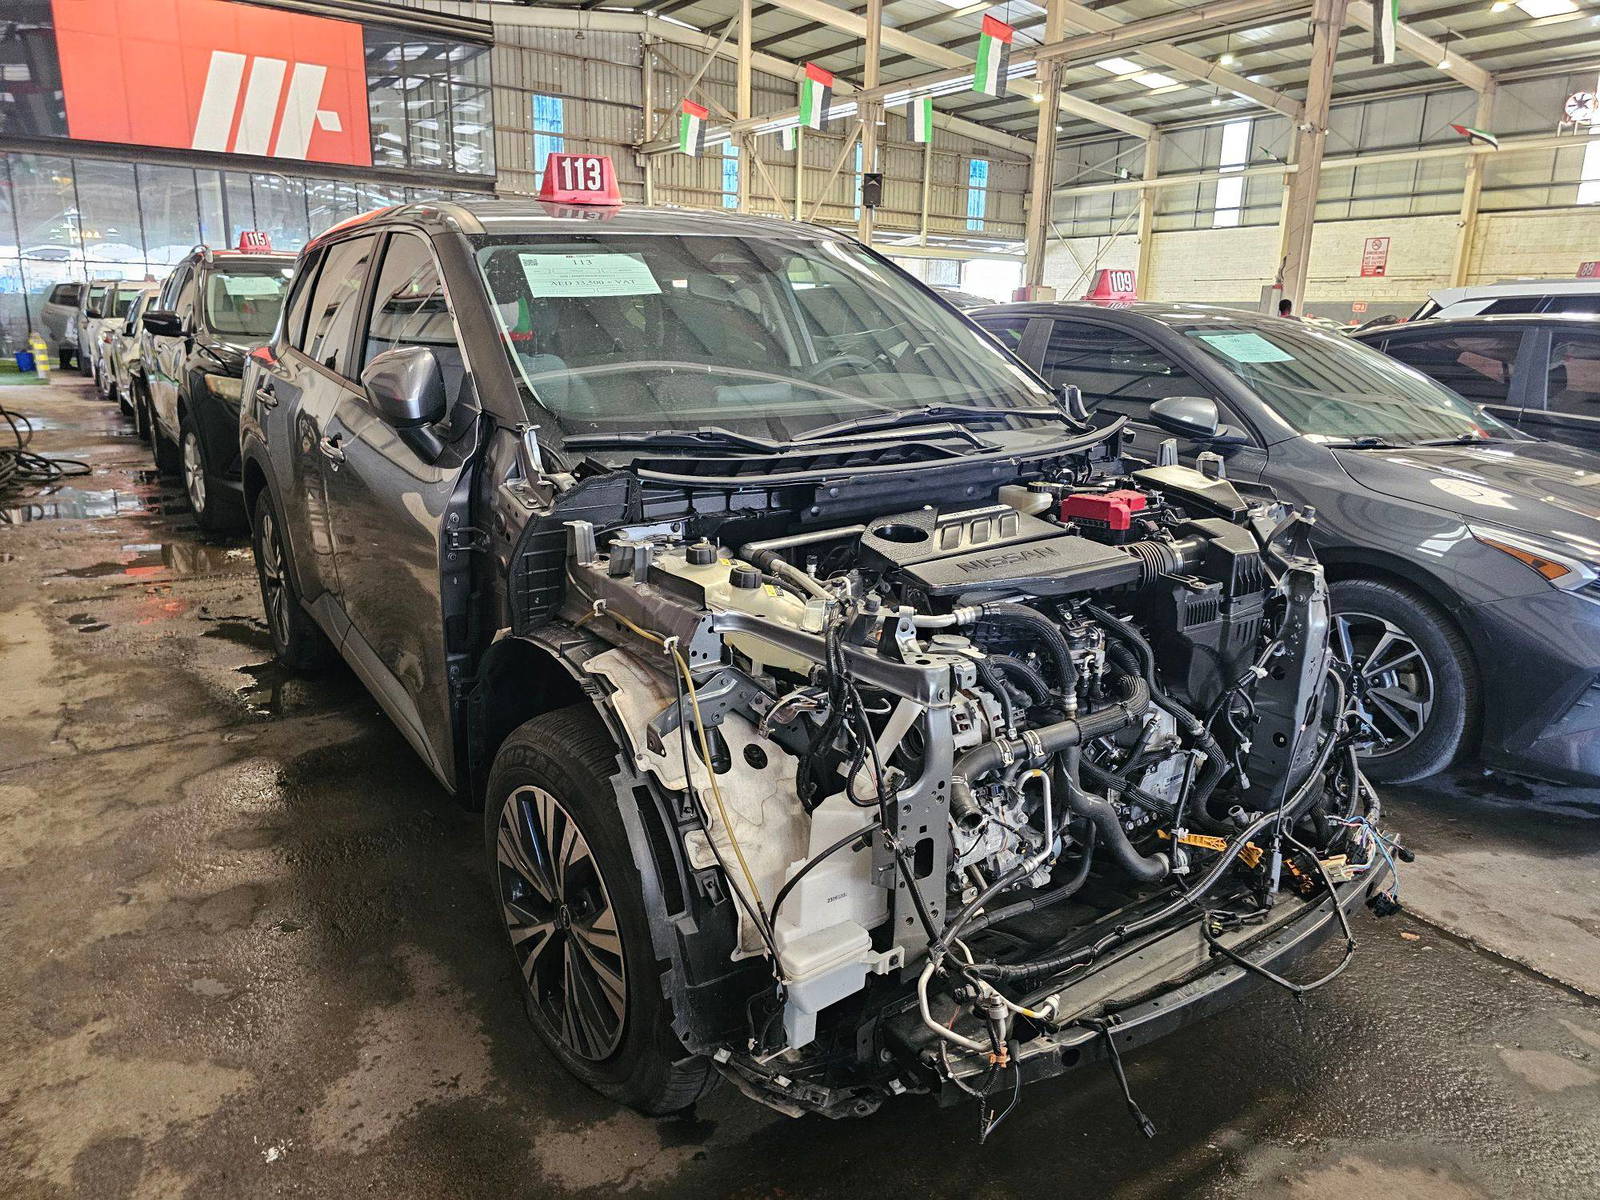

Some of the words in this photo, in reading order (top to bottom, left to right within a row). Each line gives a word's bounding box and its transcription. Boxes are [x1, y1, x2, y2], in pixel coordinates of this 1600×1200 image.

[561, 157, 601, 191] 113
[248, 232, 266, 246] 115
[1111, 271, 1132, 292] 109
[956, 546, 1059, 573] NISSAN
